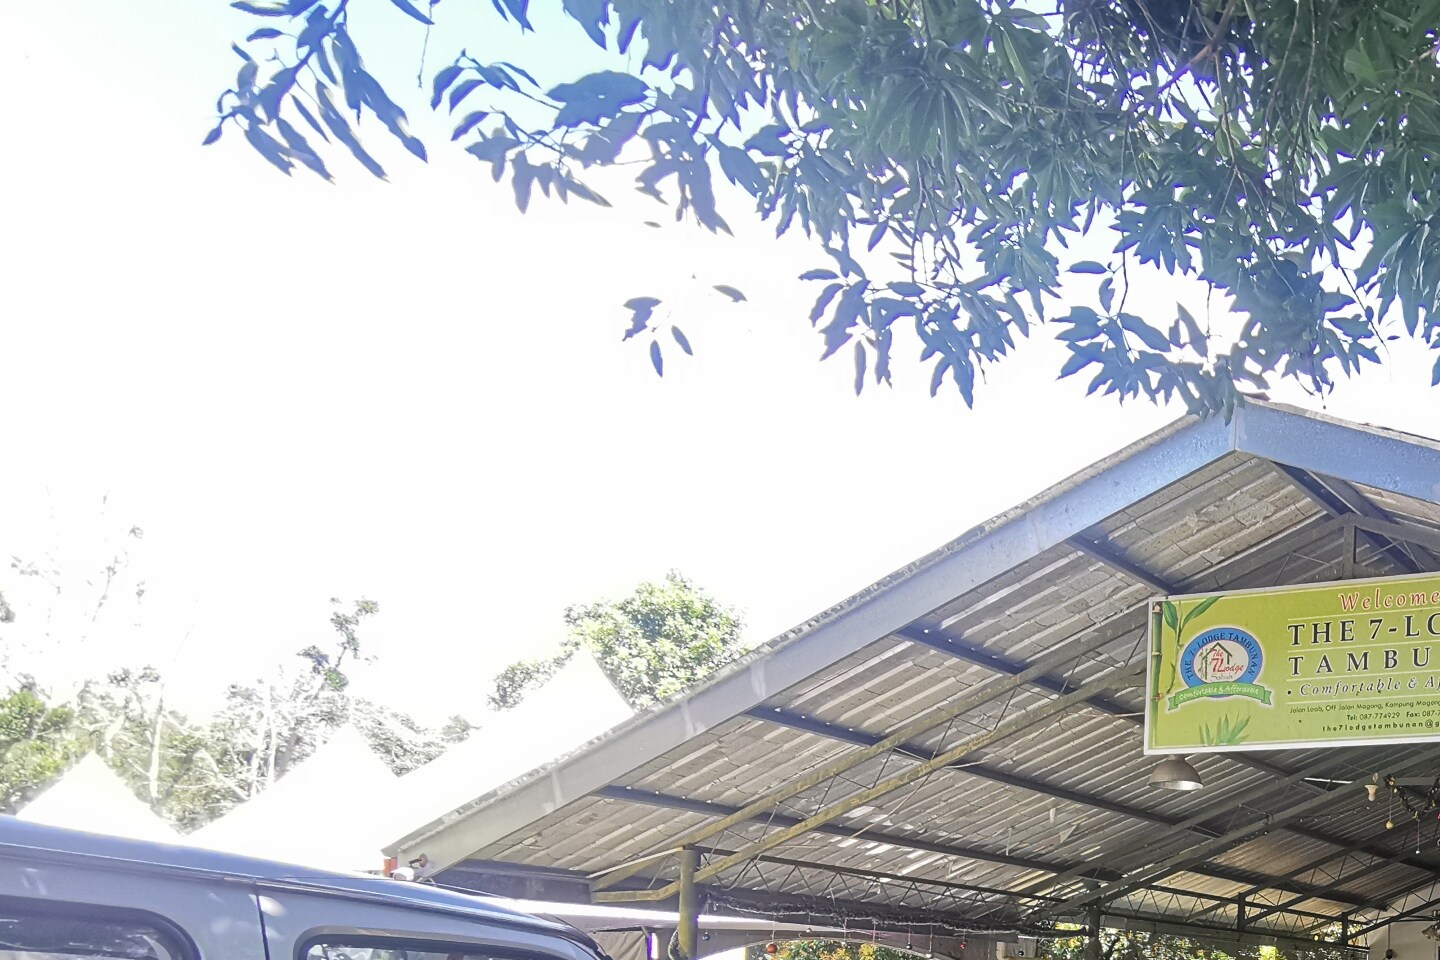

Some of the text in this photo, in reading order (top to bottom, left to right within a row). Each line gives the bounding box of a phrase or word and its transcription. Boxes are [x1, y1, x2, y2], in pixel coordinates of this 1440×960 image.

[1340, 588, 1440, 612] Welcome
[1287, 620, 1355, 646] THE
[1184, 660, 1194, 681] THE
[1300, 678, 1401, 697] Comfortable
[1407, 677, 1418, 689] &
[1290, 706, 1306, 714] Jalan
[1325, 704, 1337, 712] Off
[1338, 703, 1355, 711] Jalan
[1385, 700, 1415, 710] Kampung
[1359, 711, 1401, 720] 087-774929
